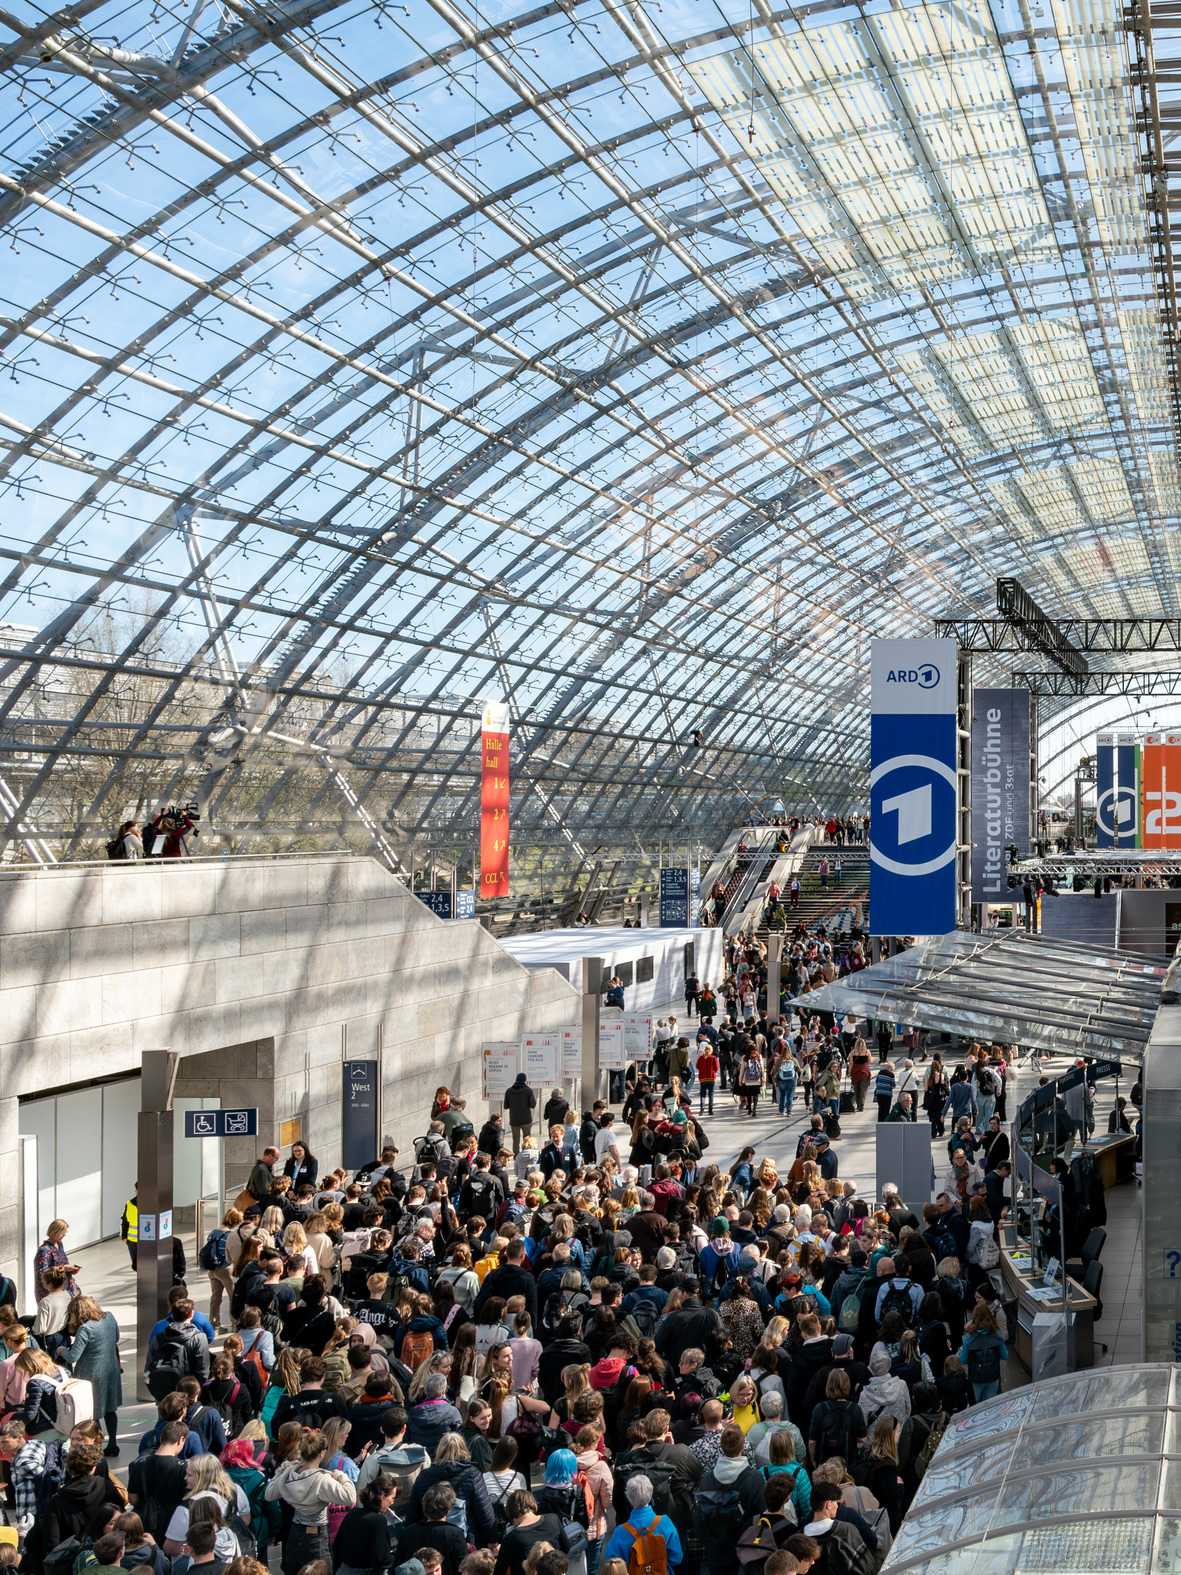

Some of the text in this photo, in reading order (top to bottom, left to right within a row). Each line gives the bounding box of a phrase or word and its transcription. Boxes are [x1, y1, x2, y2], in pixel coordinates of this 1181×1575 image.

[887, 670, 918, 682] ARD
[486, 738, 502, 750] Halle
[486, 756, 498, 768] hall
[494, 777, 498, 788] 1
[1004, 764, 1014, 790] 3sat
[982, 708, 1001, 892] Literaturbühne
[1006, 793, 1014, 815] und
[494, 809, 498, 820] 2
[1004, 818, 1014, 840] ZDF
[494, 840, 499, 851] 4
[485, 873, 498, 883] CCL
[431, 894, 443, 903] 2,4
[432, 904, 449, 912] 1,3,5
[1095, 1064, 1111, 1074] PRESSE
[351, 1083, 370, 1091] West
